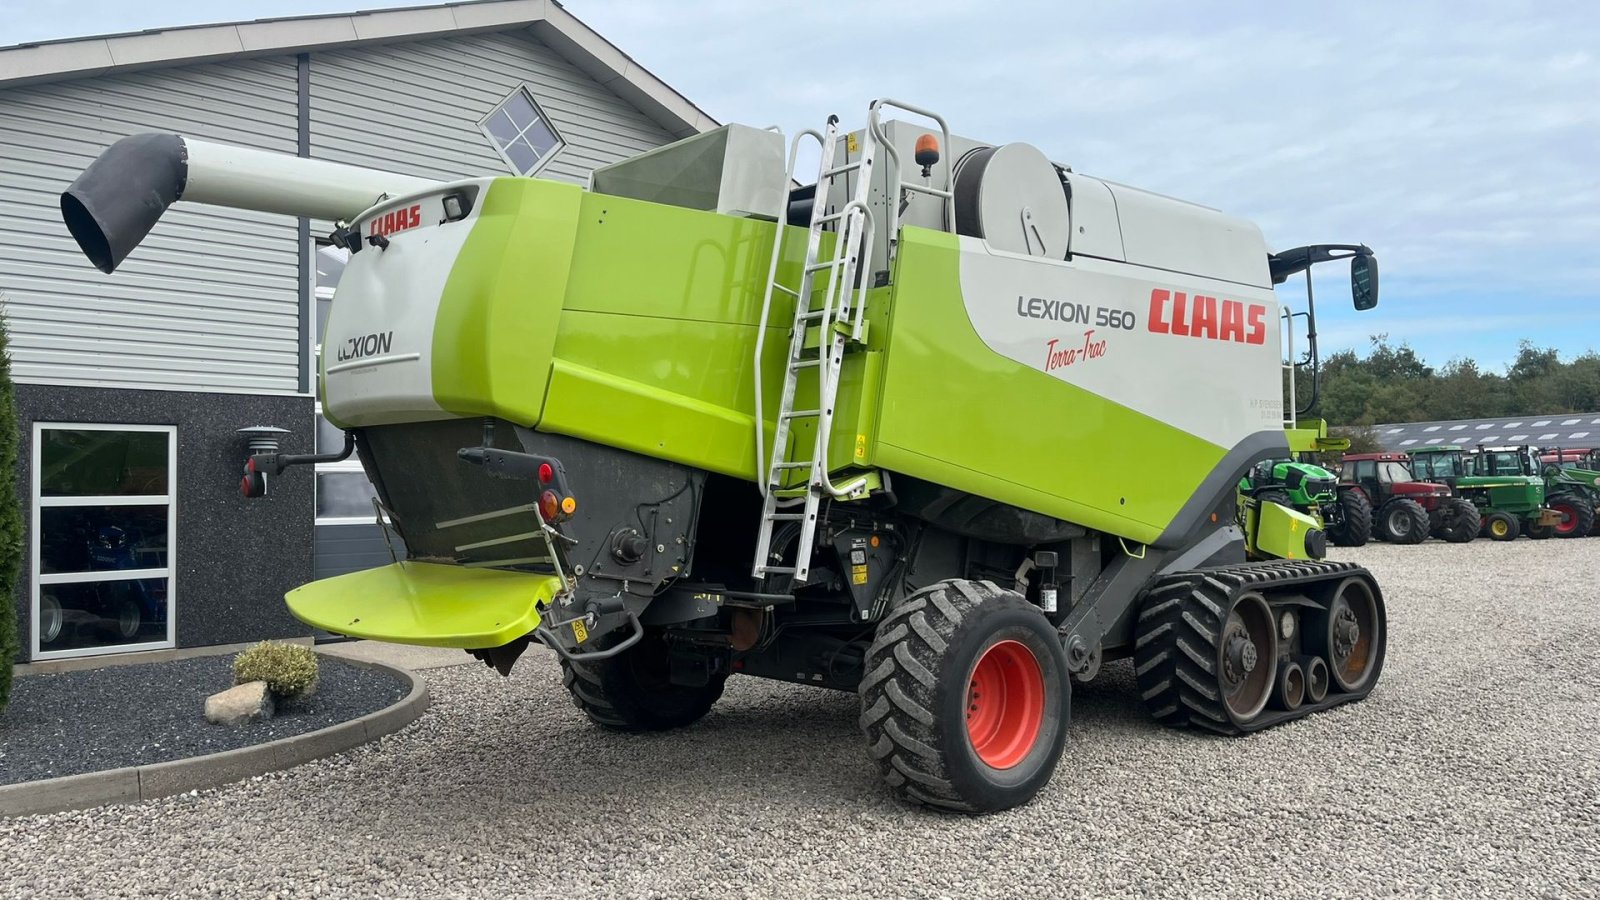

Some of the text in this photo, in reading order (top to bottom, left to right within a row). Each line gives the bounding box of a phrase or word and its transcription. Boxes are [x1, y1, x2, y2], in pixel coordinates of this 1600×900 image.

[1017, 295, 1136, 331] LEXION 560
[1147, 288, 1266, 345] CLAAS
[1045, 329, 1107, 372] Terra-Trac
